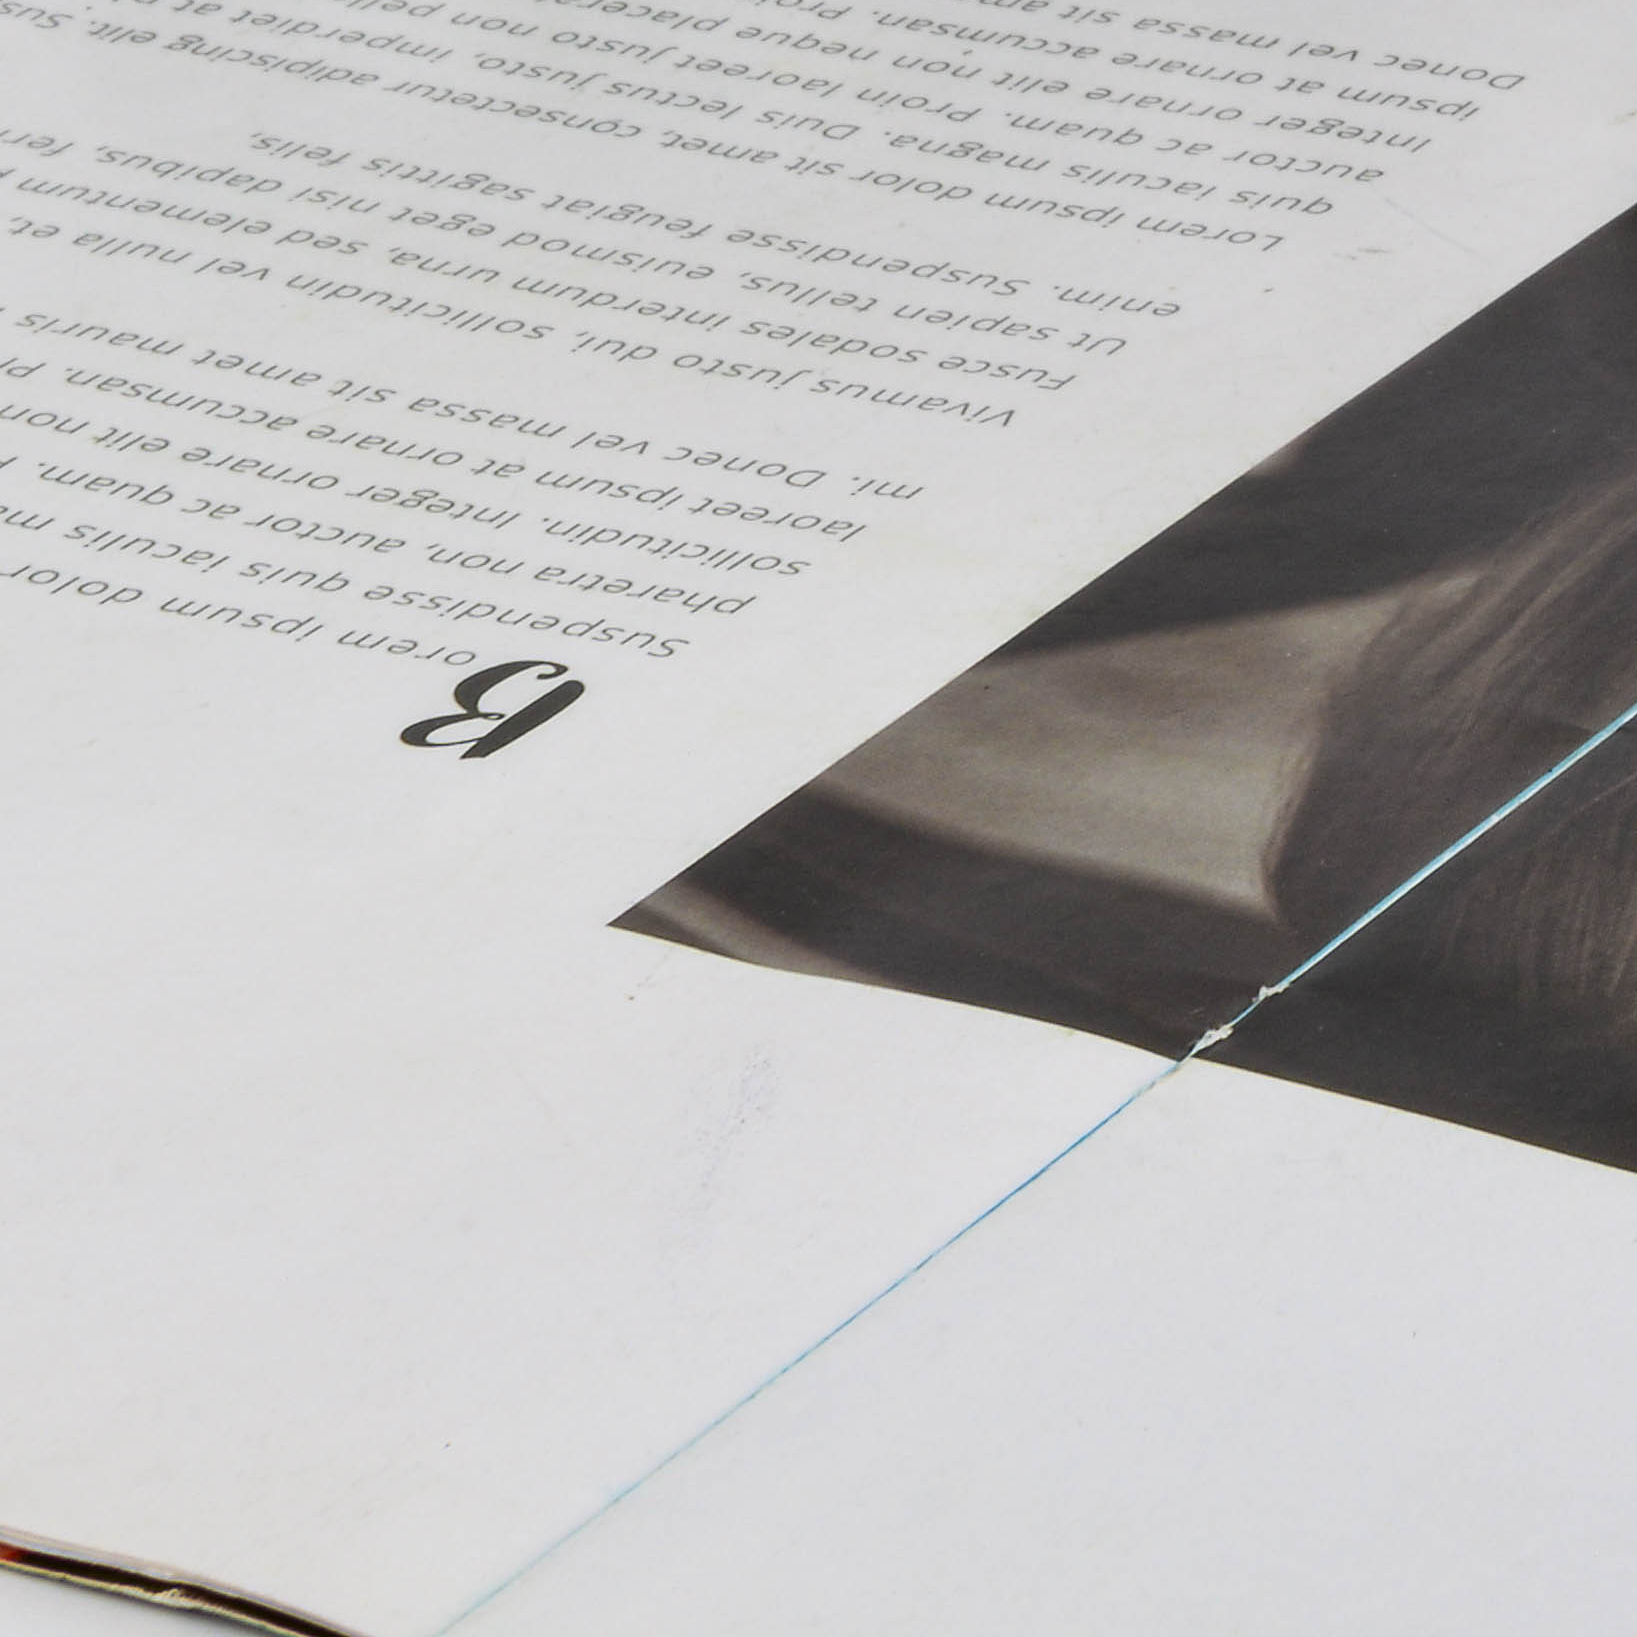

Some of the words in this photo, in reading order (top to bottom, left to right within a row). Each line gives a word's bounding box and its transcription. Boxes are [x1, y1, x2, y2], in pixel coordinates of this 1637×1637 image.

[449, 11, 540, 38] non
[1056, 4, 1122, 25] sit
[1131, 16, 1282, 50] massa
[227, 8, 455, 65] imperdiet
[549, 30, 681, 66] justo
[734, 25, 880, 62] neque
[1286, 40, 1361, 63] vel
[161, 33, 381, 87] adipiscing
[672, 53, 845, 99] laoreet
[890, 54, 984, 81] non
[1110, 51, 1265, 86] ornare
[1372, 53, 1527, 92] Donec
[601, 81, 745, 121] lectus
[989, 71, 1072, 95] elit
[1272, 76, 1327, 95] at
[381, 80, 644, 139] consectetur
[855, 87, 984, 124] Proin
[1083, 86, 1244, 122] ornare
[1335, 85, 1481, 123] ipsum
[0, 128, 76, 158] fer
[753, 109, 863, 142] Duis
[1252, 114, 1433, 155] Integer
[783, 155, 846, 177] sit
[1154, 137, 1215, 157] ac
[359, 157, 537, 202] sagittis
[847, 169, 975, 202] dolor
[1060, 163, 1218, 202] iaculis
[1221, 149, 1386, 184] auctor
[15, 176, 274, 236] elementum
[286, 186, 382, 215] nisi
[539, 193, 714, 240] feugiat
[982, 191, 1127, 230] ipsum
[1227, 189, 1335, 216] quis
[386, 205, 497, 238] eget
[1135, 215, 1286, 253] Lorem
[71, 231, 194, 266] nulla
[273, 228, 370, 256] sed
[498, 230, 716, 281] euismod
[192, 256, 272, 282] vel
[724, 228, 1032, 297] Suspendisse
[284, 273, 557, 341] sollicitudin
[510, 275, 733, 333] interdum
[891, 303, 1061, 342] sapien
[12, 312, 186, 357] mauris
[738, 320, 929, 364] sodales
[1065, 331, 1128, 357] Ut
[190, 348, 324, 388] amet
[671, 353, 815, 391] justo
[936, 354, 1079, 392] Fusce
[326, 378, 399, 404] sit
[808, 378, 1017, 429] Vivamus
[406, 395, 569, 439] massa
[90, 425, 172, 454] elit
[304, 423, 465, 467] ornare
[568, 430, 652, 457] vel
[177, 445, 341, 491] ornare
[468, 457, 527, 479] at
[660, 445, 829, 490] Donec
[178, 497, 243, 521] ac
[343, 484, 523, 531] Integer
[532, 469, 686, 512] ipsum
[241, 513, 408, 555] auctor
[686, 495, 868, 544] laoreet
[61, 523, 232, 574] iaculis
[236, 561, 352, 593] quis
[531, 564, 759, 616] pharetra
[158, 595, 326, 644] ipsum
[360, 584, 692, 659] Suspendisse
